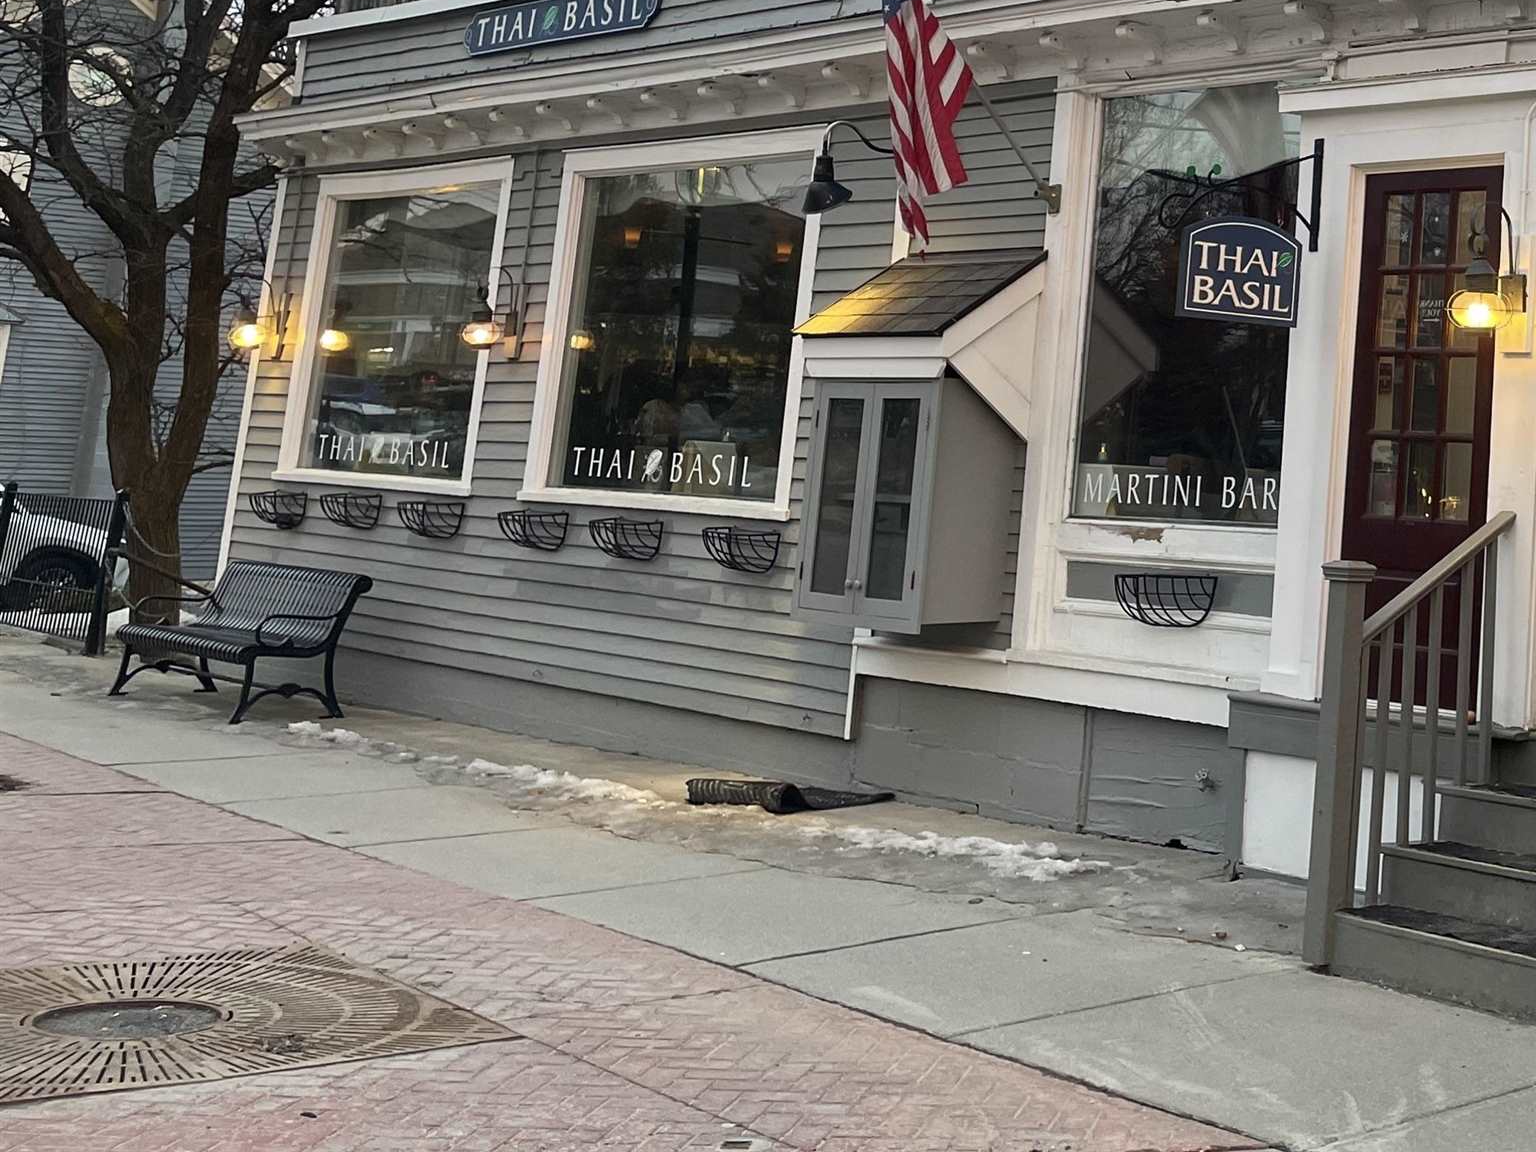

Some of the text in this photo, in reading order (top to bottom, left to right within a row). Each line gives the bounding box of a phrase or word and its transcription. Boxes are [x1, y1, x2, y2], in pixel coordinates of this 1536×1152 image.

[477, 8, 537, 48] THAI
[1193, 240, 1279, 277] THAI
[1192, 275, 1290, 313] BASIL
[319, 434, 449, 469] THAI BASIL
[573, 447, 752, 488] THAI BASIL
[1083, 473, 1278, 510] MARTINI BAR
